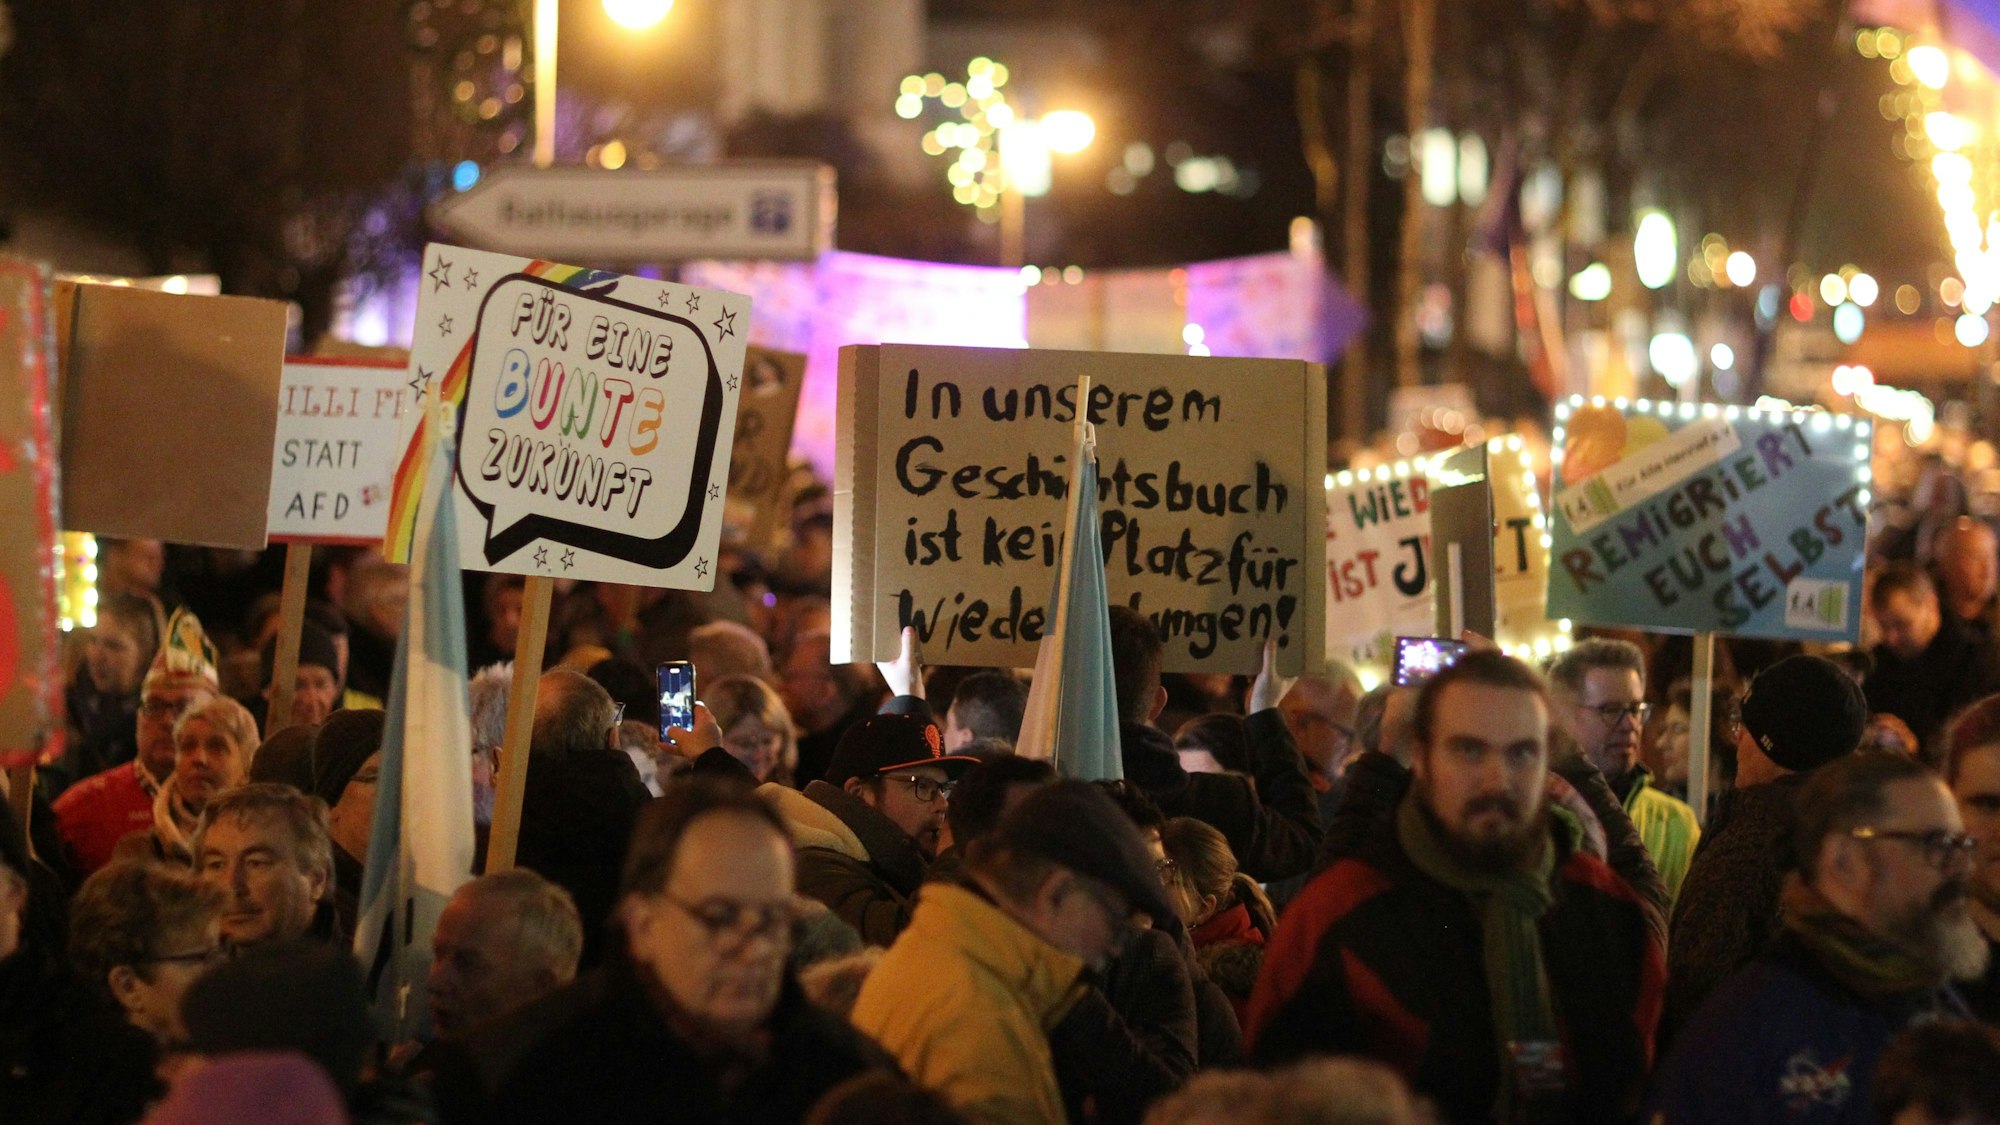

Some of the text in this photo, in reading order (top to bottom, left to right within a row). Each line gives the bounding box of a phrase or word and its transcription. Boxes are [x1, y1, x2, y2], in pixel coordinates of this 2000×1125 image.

[511, 288, 674, 379] FÜR EINE
[278, 384, 361, 418] ILLI
[495, 348, 665, 456] BUNTE
[904, 368, 1221, 431] In unserem
[281, 438, 363, 468] STATT
[285, 491, 350, 521] AFD
[904, 508, 1298, 594] ist kei Platz für
[1645, 513, 1760, 608] EUCH
[1711, 485, 1866, 629] SELBST
